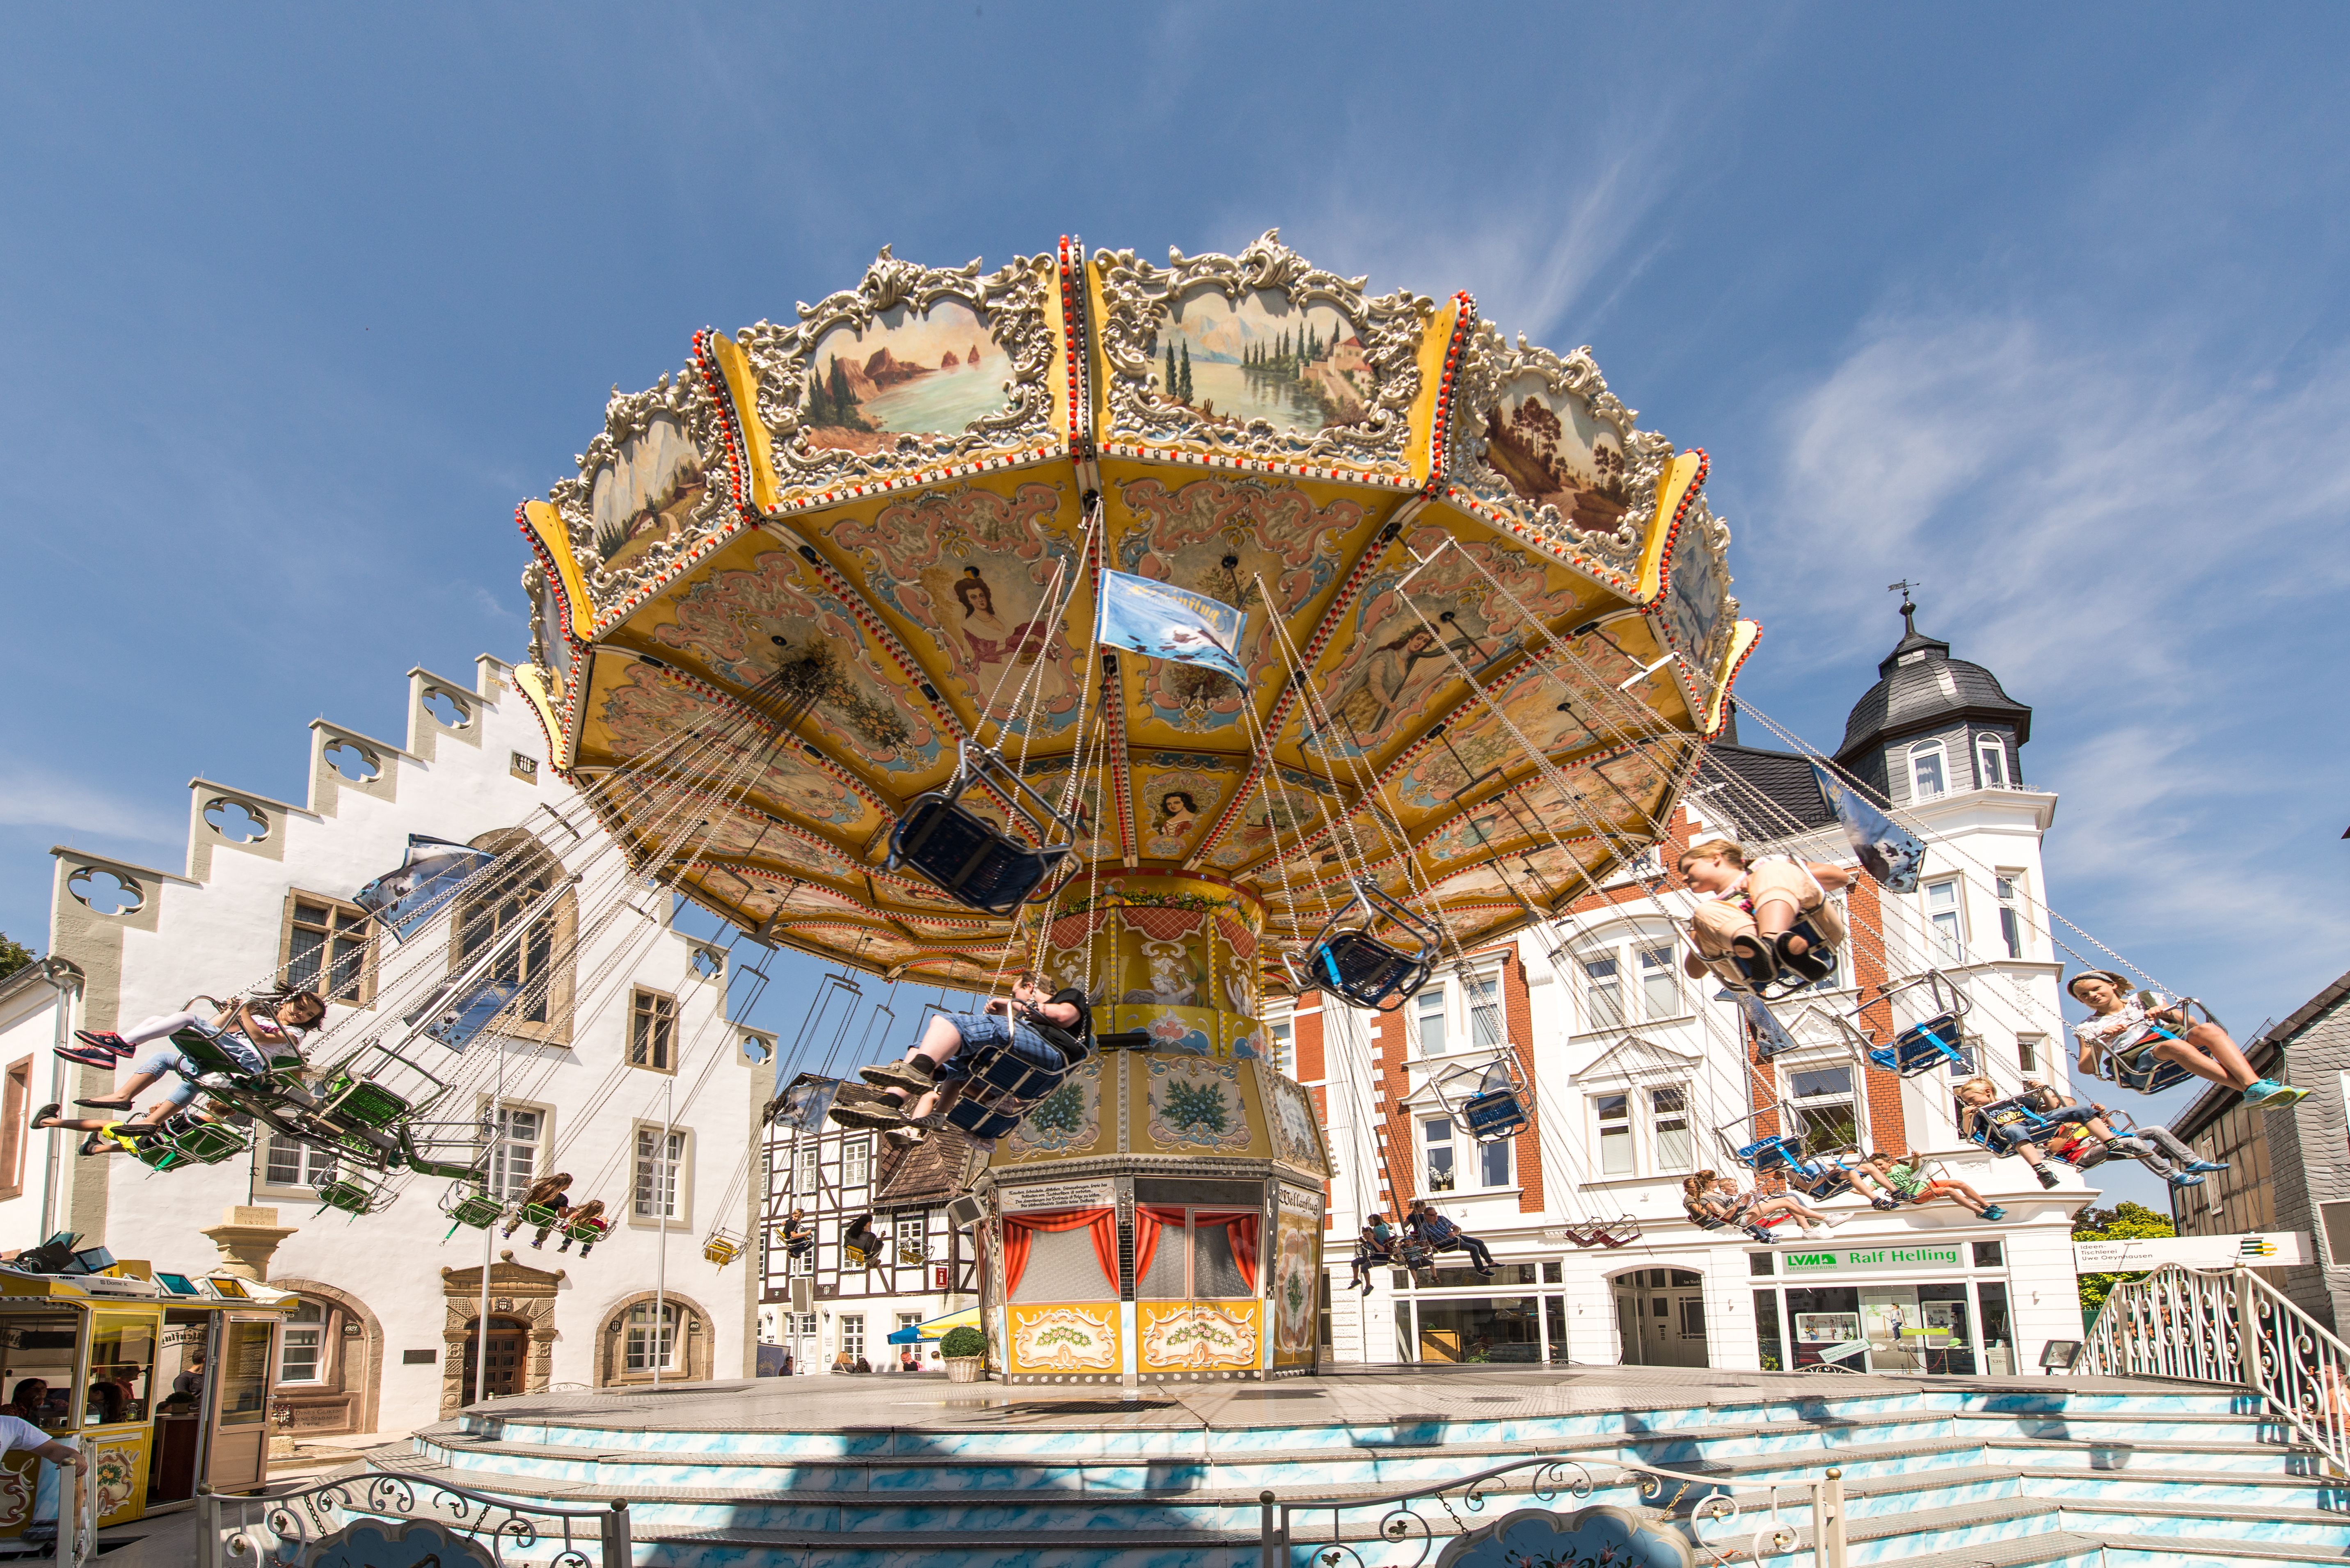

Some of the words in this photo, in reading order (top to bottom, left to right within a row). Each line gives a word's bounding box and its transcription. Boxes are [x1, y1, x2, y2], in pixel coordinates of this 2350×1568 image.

[1279, 1189, 1320, 1215] Wellenflug
[1787, 1255, 1819, 1266] LVM
[1850, 1251, 1885, 1264] Ralf
[1892, 1249, 1956, 1263] Helling
